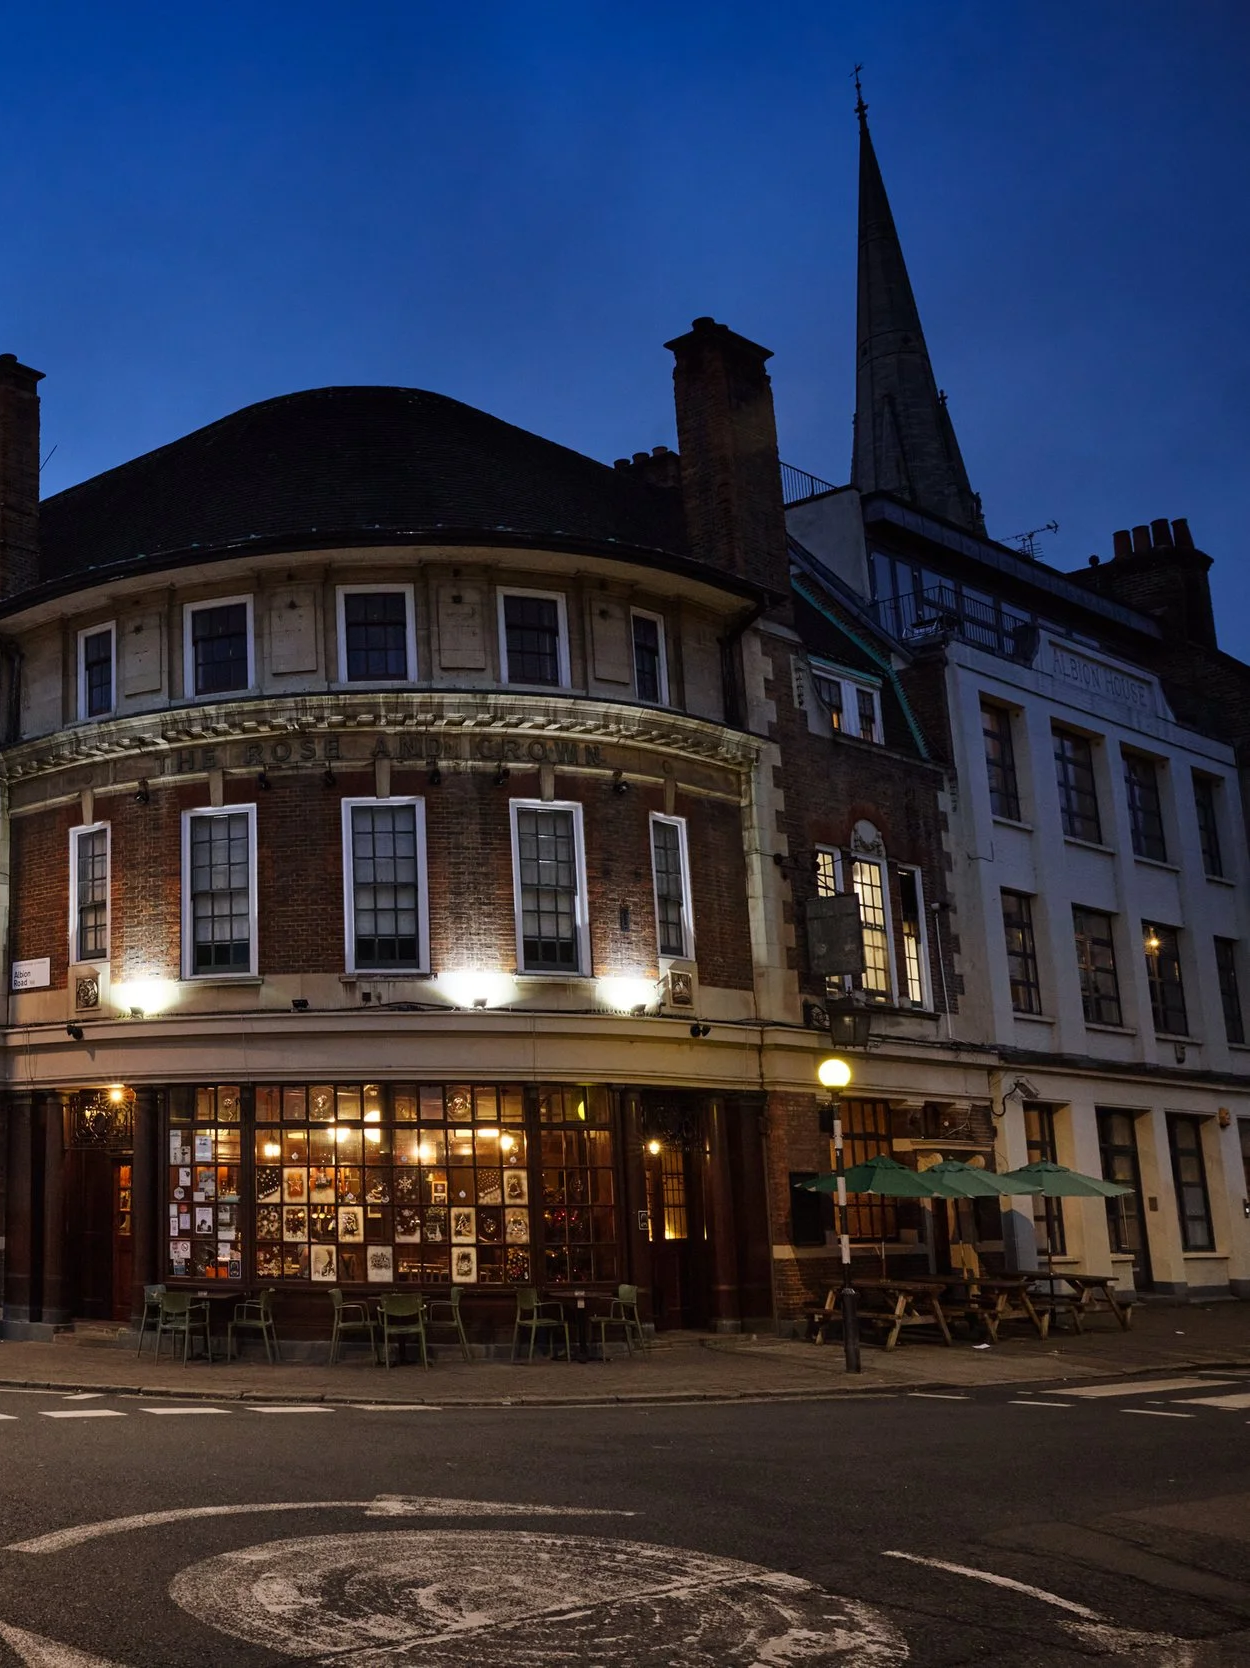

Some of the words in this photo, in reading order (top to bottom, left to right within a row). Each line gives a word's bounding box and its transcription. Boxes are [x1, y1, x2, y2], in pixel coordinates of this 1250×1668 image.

[1052, 648, 1102, 690] ALBION
[1104, 671, 1148, 708] HOUSE
[154, 746, 217, 775] THE
[245, 735, 340, 765] ROSE
[371, 735, 443, 758] AND
[477, 737, 602, 766] CROWN
[14, 970, 31, 979] Albion
[14, 979, 28, 987] Road
